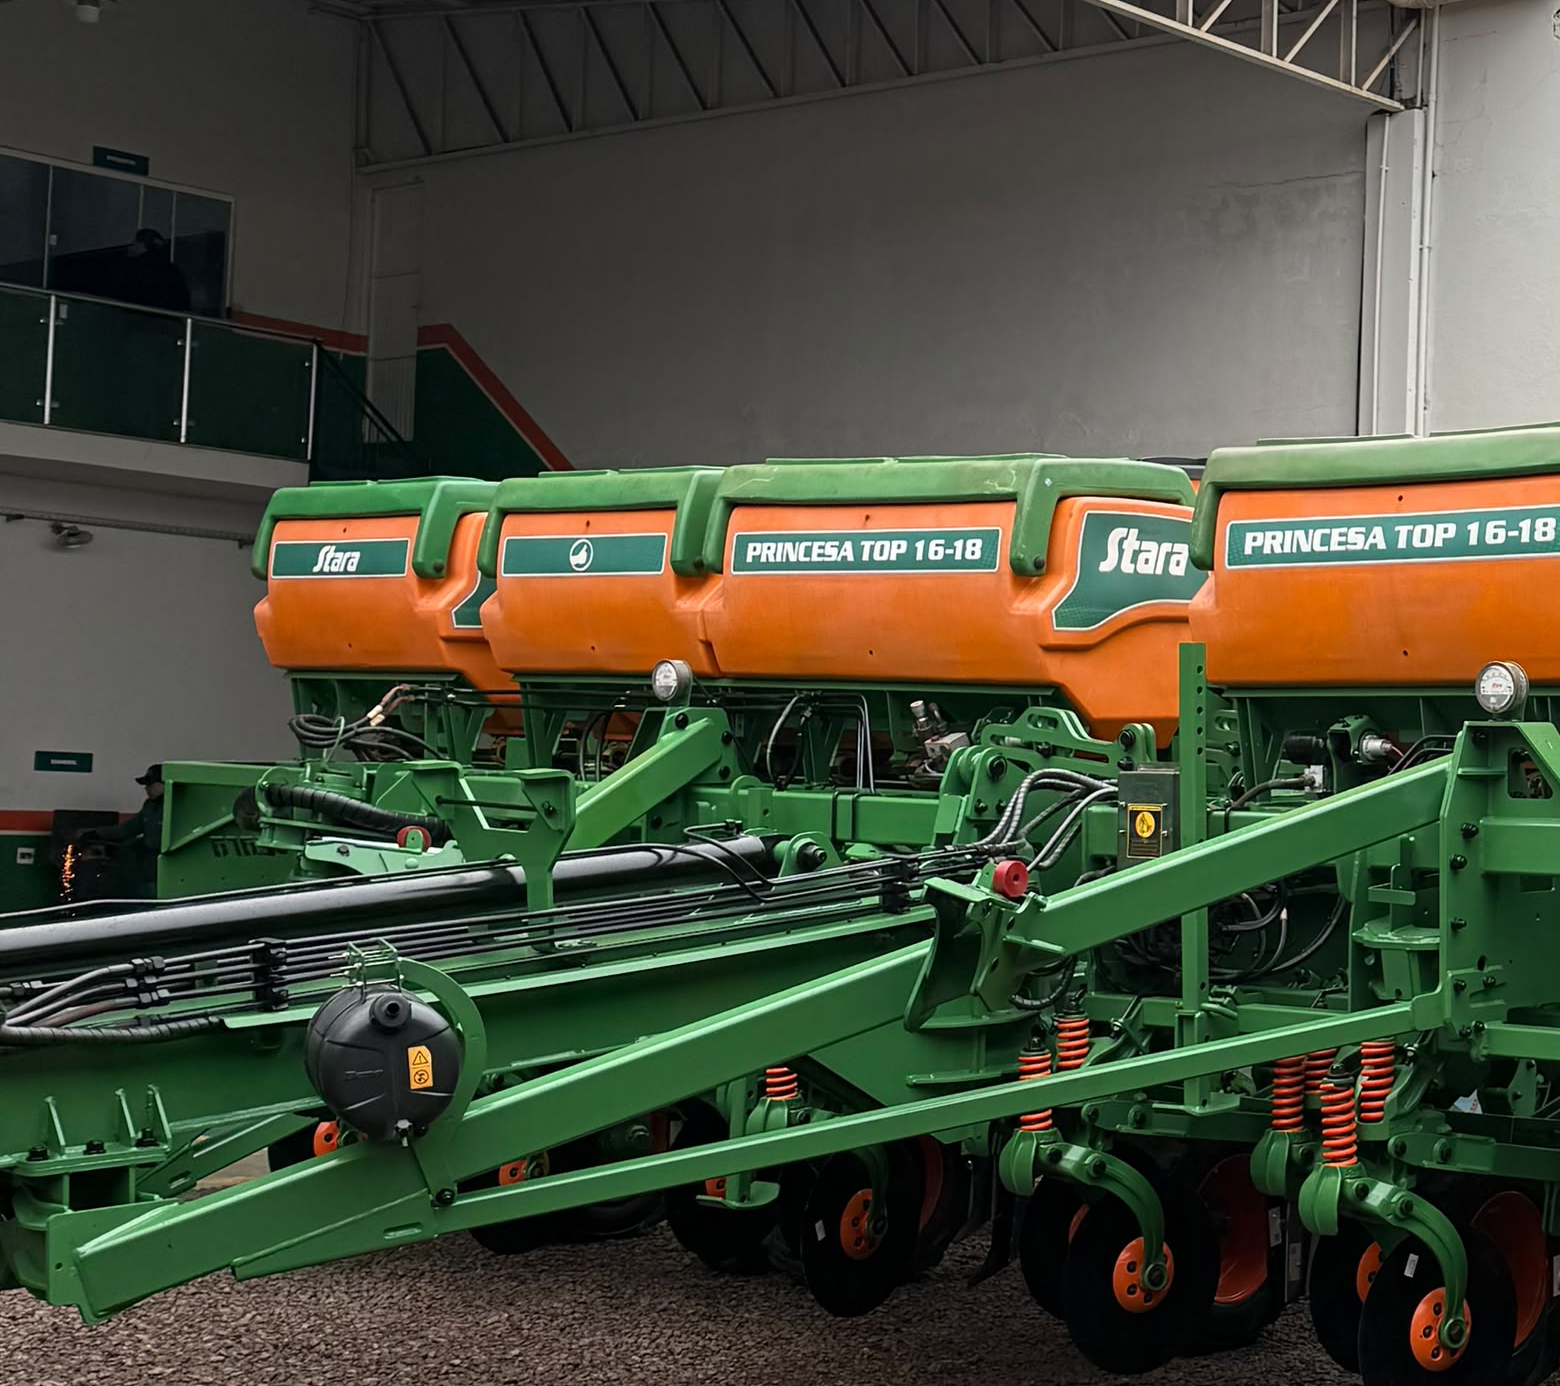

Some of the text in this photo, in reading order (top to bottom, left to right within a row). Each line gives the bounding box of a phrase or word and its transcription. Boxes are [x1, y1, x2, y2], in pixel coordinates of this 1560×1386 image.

[746, 538, 983, 563] PRINCESA TOP 16-18
[1099, 527, 1189, 576] Stara
[1243, 517, 1557, 555] PRINCESA TOP 16-18
[312, 545, 361, 573] Stara
